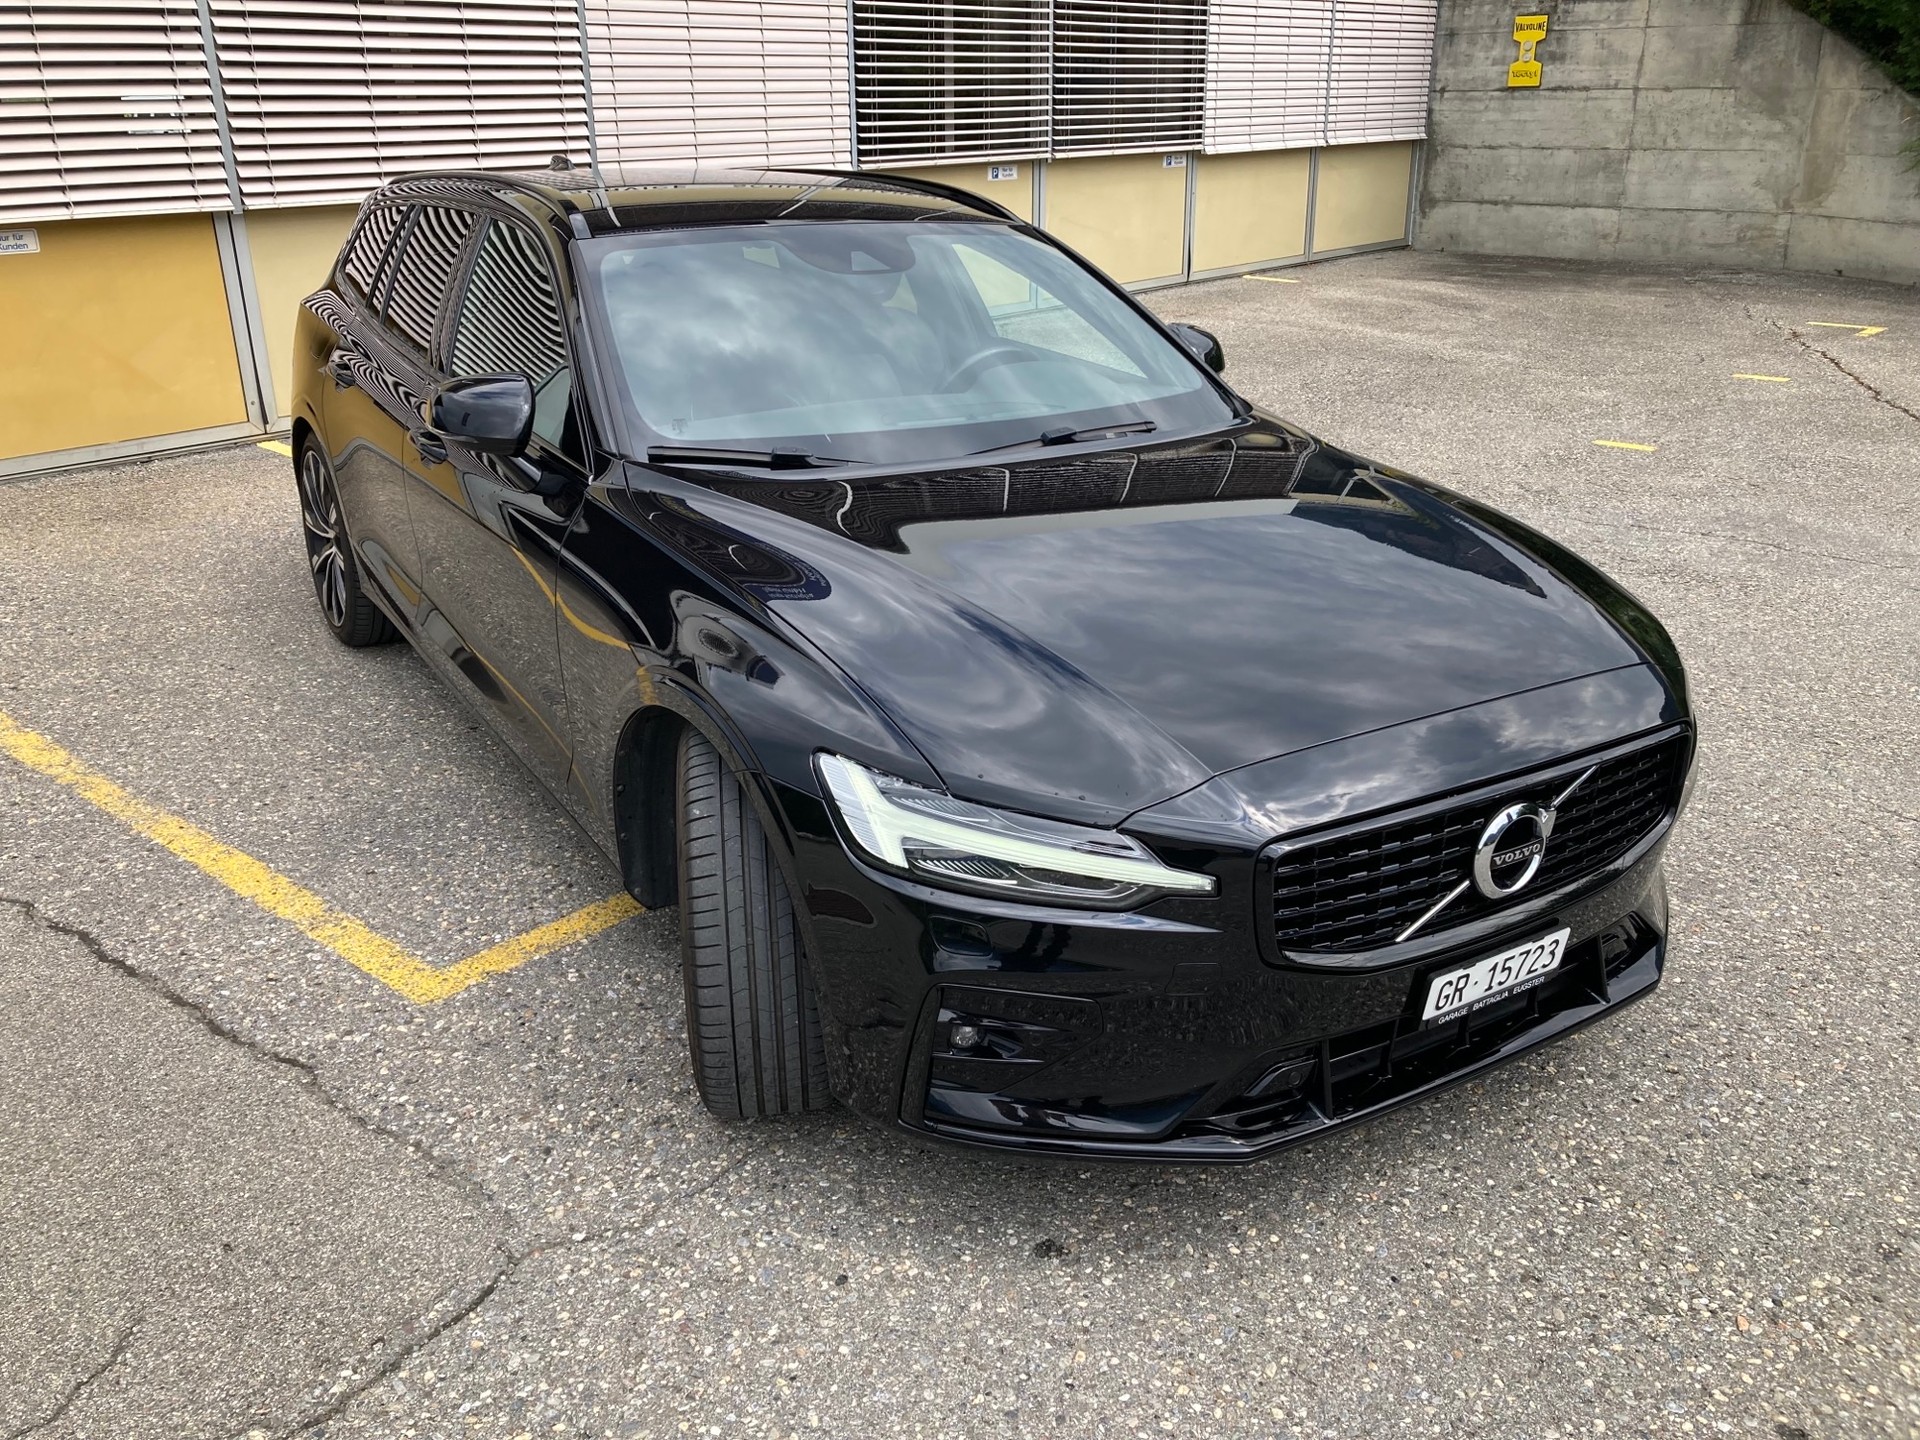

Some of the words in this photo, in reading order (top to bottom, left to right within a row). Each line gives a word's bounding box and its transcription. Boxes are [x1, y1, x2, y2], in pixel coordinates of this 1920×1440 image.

[1515, 21, 1546, 33] VALVOLINE
[1493, 843, 1541, 866] VOLVO
[1438, 1006, 1468, 1025] GARAGE
[1472, 990, 1509, 1011] BATTAGLIA
[1513, 976, 1545, 995] EUGSTER
